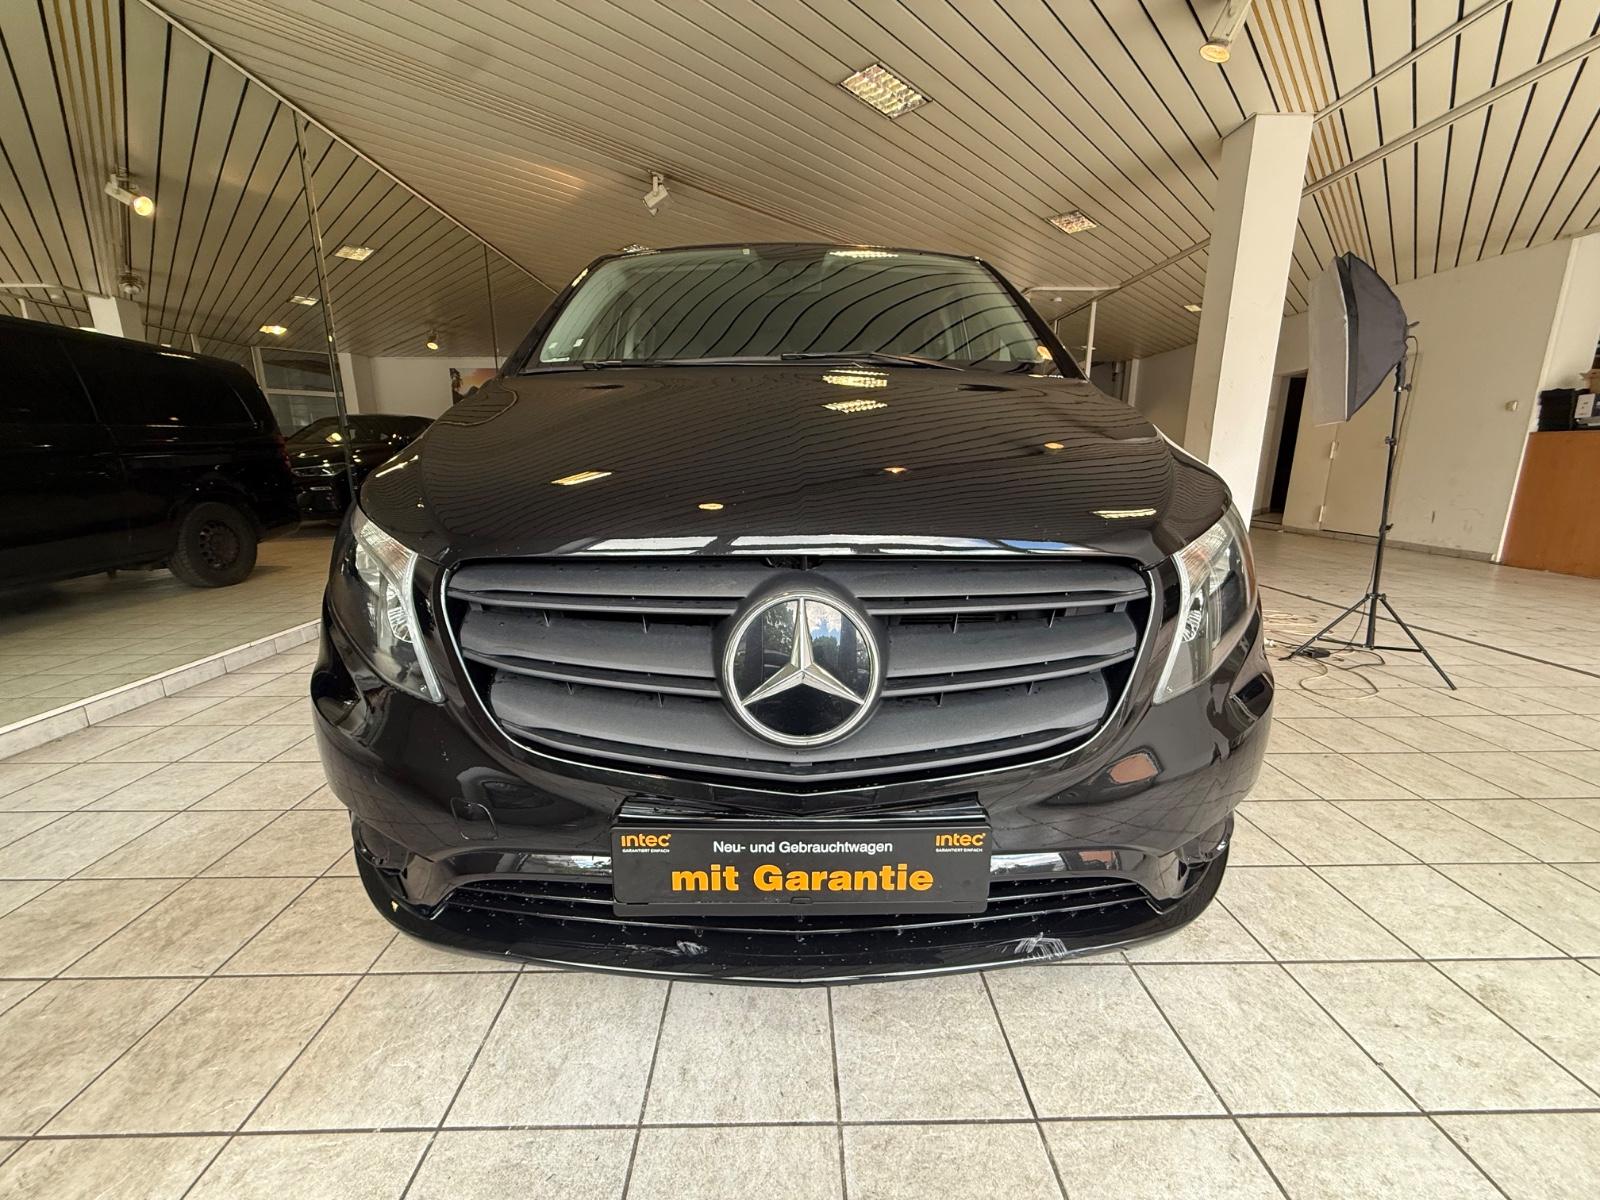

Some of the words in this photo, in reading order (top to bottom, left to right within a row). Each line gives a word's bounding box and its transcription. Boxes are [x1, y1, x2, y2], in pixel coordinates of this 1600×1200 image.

[712, 840, 746, 854] Neu-
[750, 840, 776, 854] und
[778, 840, 894, 855] Gebrauchtwagen
[671, 863, 740, 892] mit
[752, 863, 935, 893] Garantie
